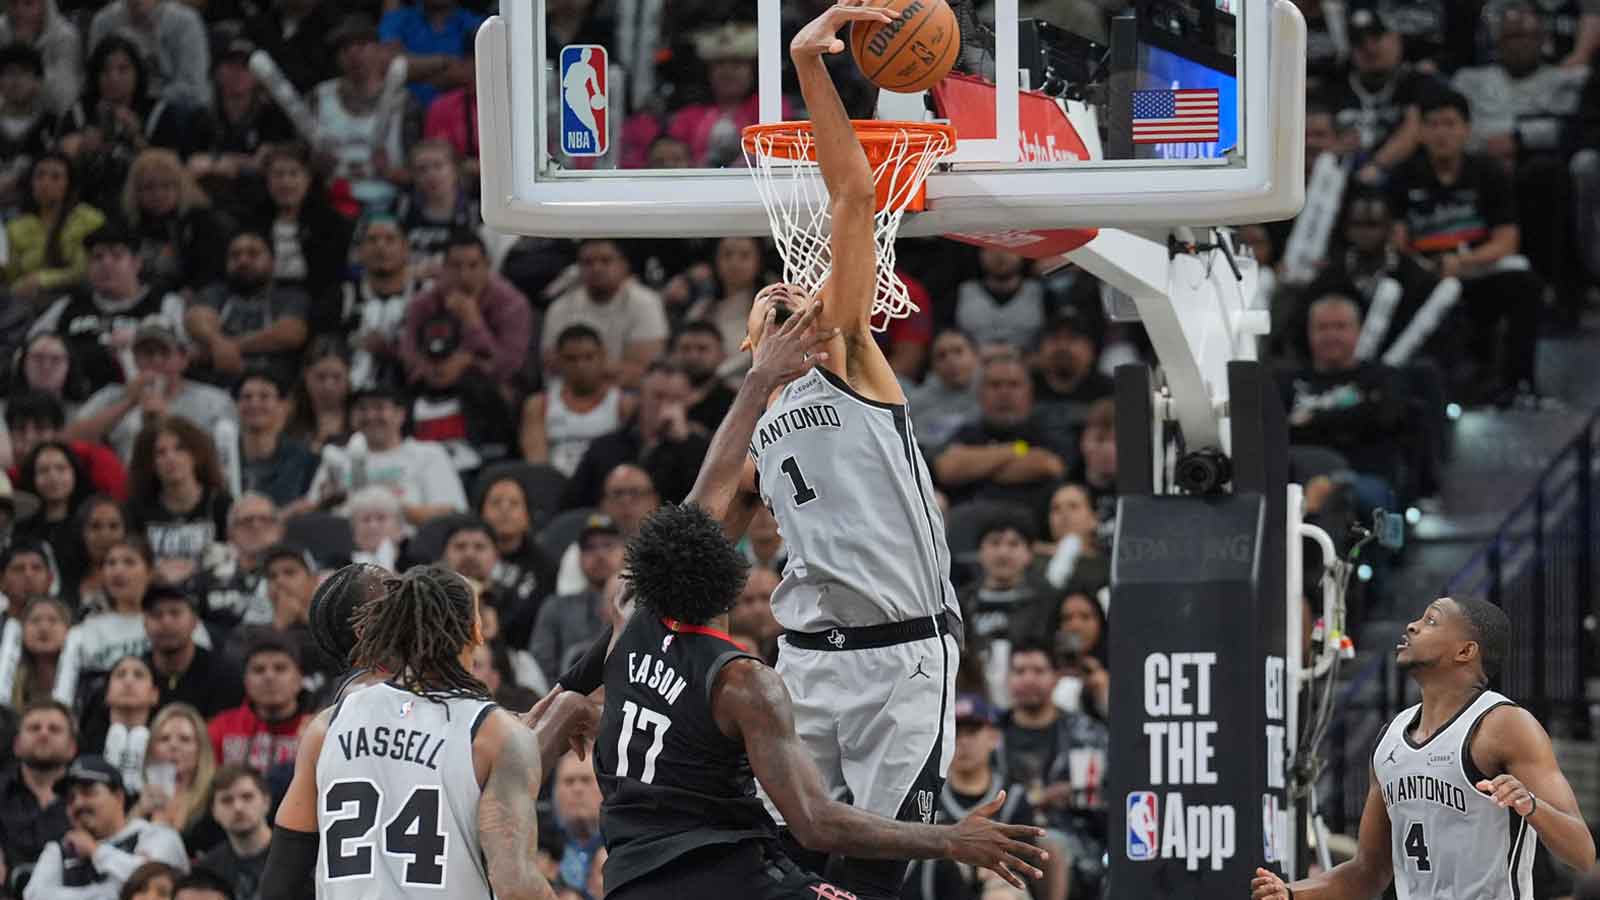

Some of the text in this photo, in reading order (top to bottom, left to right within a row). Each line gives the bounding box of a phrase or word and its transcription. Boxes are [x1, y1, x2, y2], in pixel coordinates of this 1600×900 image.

[867, 1, 925, 56] Wilson
[567, 131, 590, 149] NBA
[760, 405, 841, 450] ANTONIO
[780, 455, 817, 506] 1
[628, 651, 687, 706] EASON
[1144, 652, 1217, 716] GET
[338, 727, 445, 770] VASSELL
[616, 700, 672, 784] 17
[1143, 721, 1218, 785] THE
[1398, 775, 1466, 813] ANTONIO
[325, 779, 447, 887] 24
[1161, 792, 1236, 871] App
[1404, 822, 1431, 871] 4
